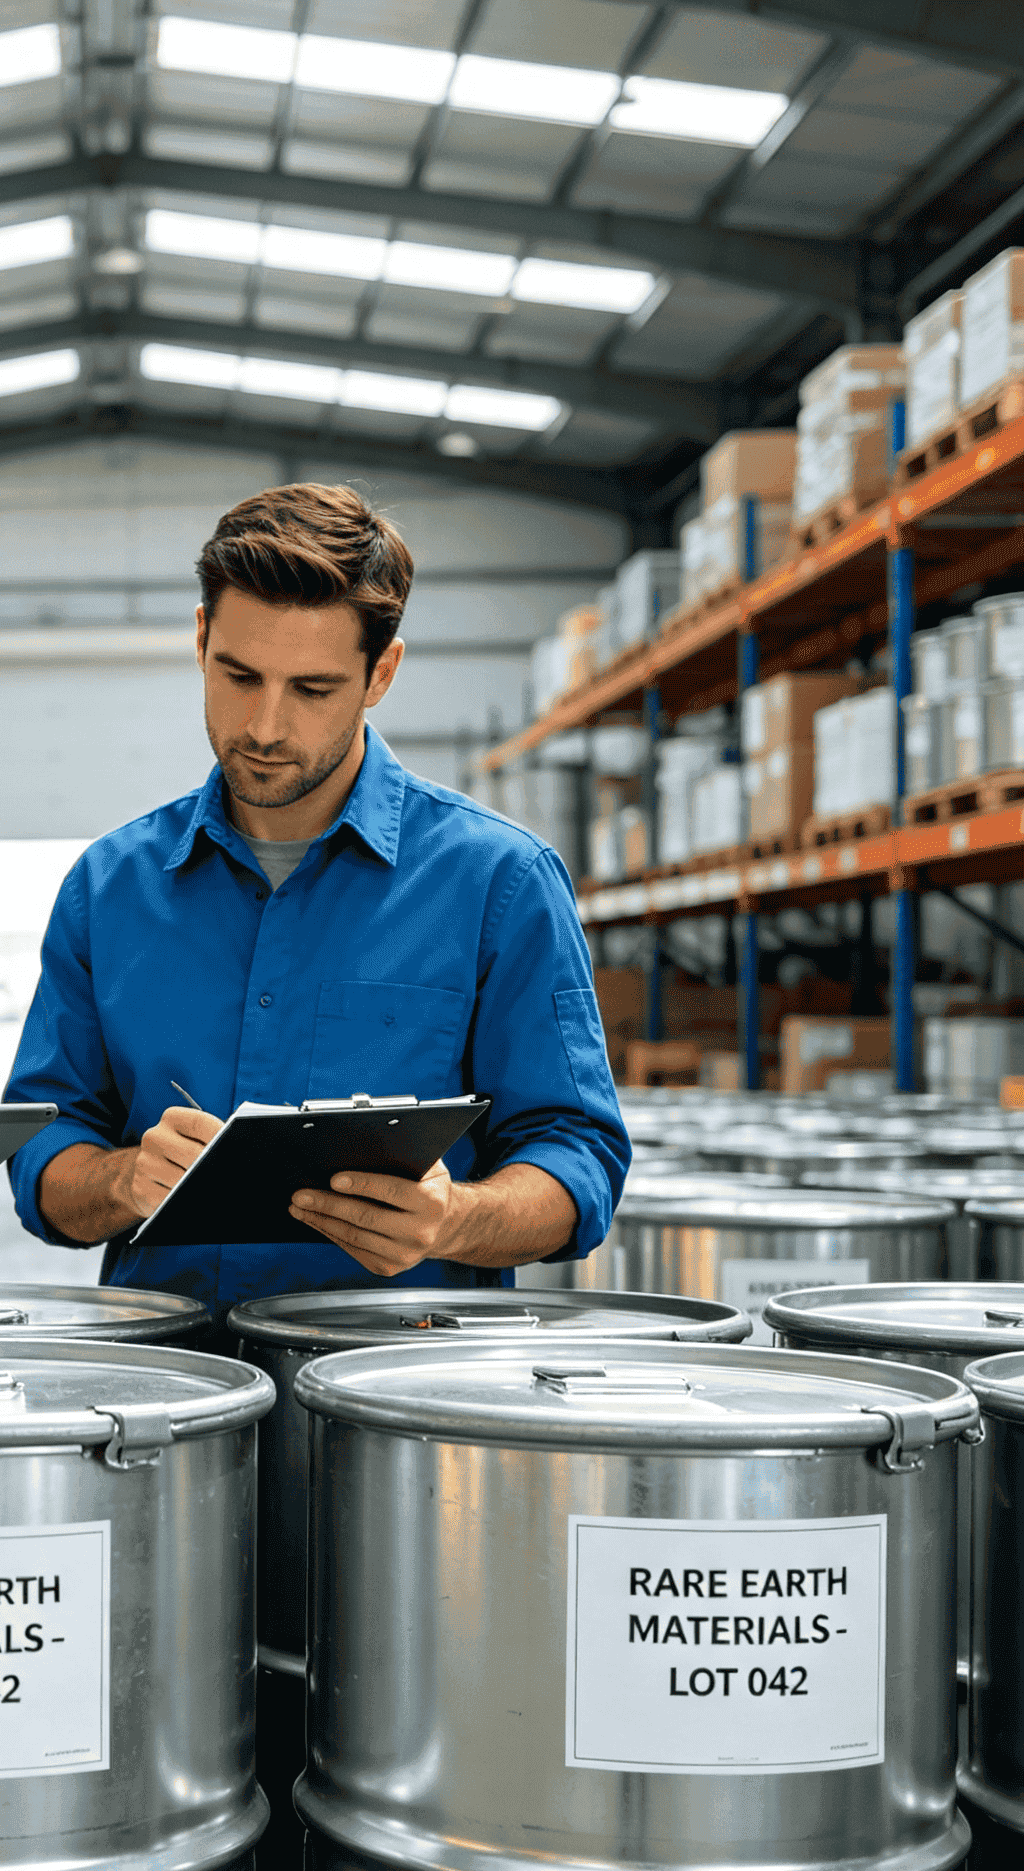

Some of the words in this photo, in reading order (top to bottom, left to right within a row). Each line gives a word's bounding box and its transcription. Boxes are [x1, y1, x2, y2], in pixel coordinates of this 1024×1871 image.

[629, 1567, 728, 1599] RARE
[741, 1566, 847, 1599] EARTH
[669, 1666, 739, 1697] LOT
[747, 1665, 809, 1697] 042
